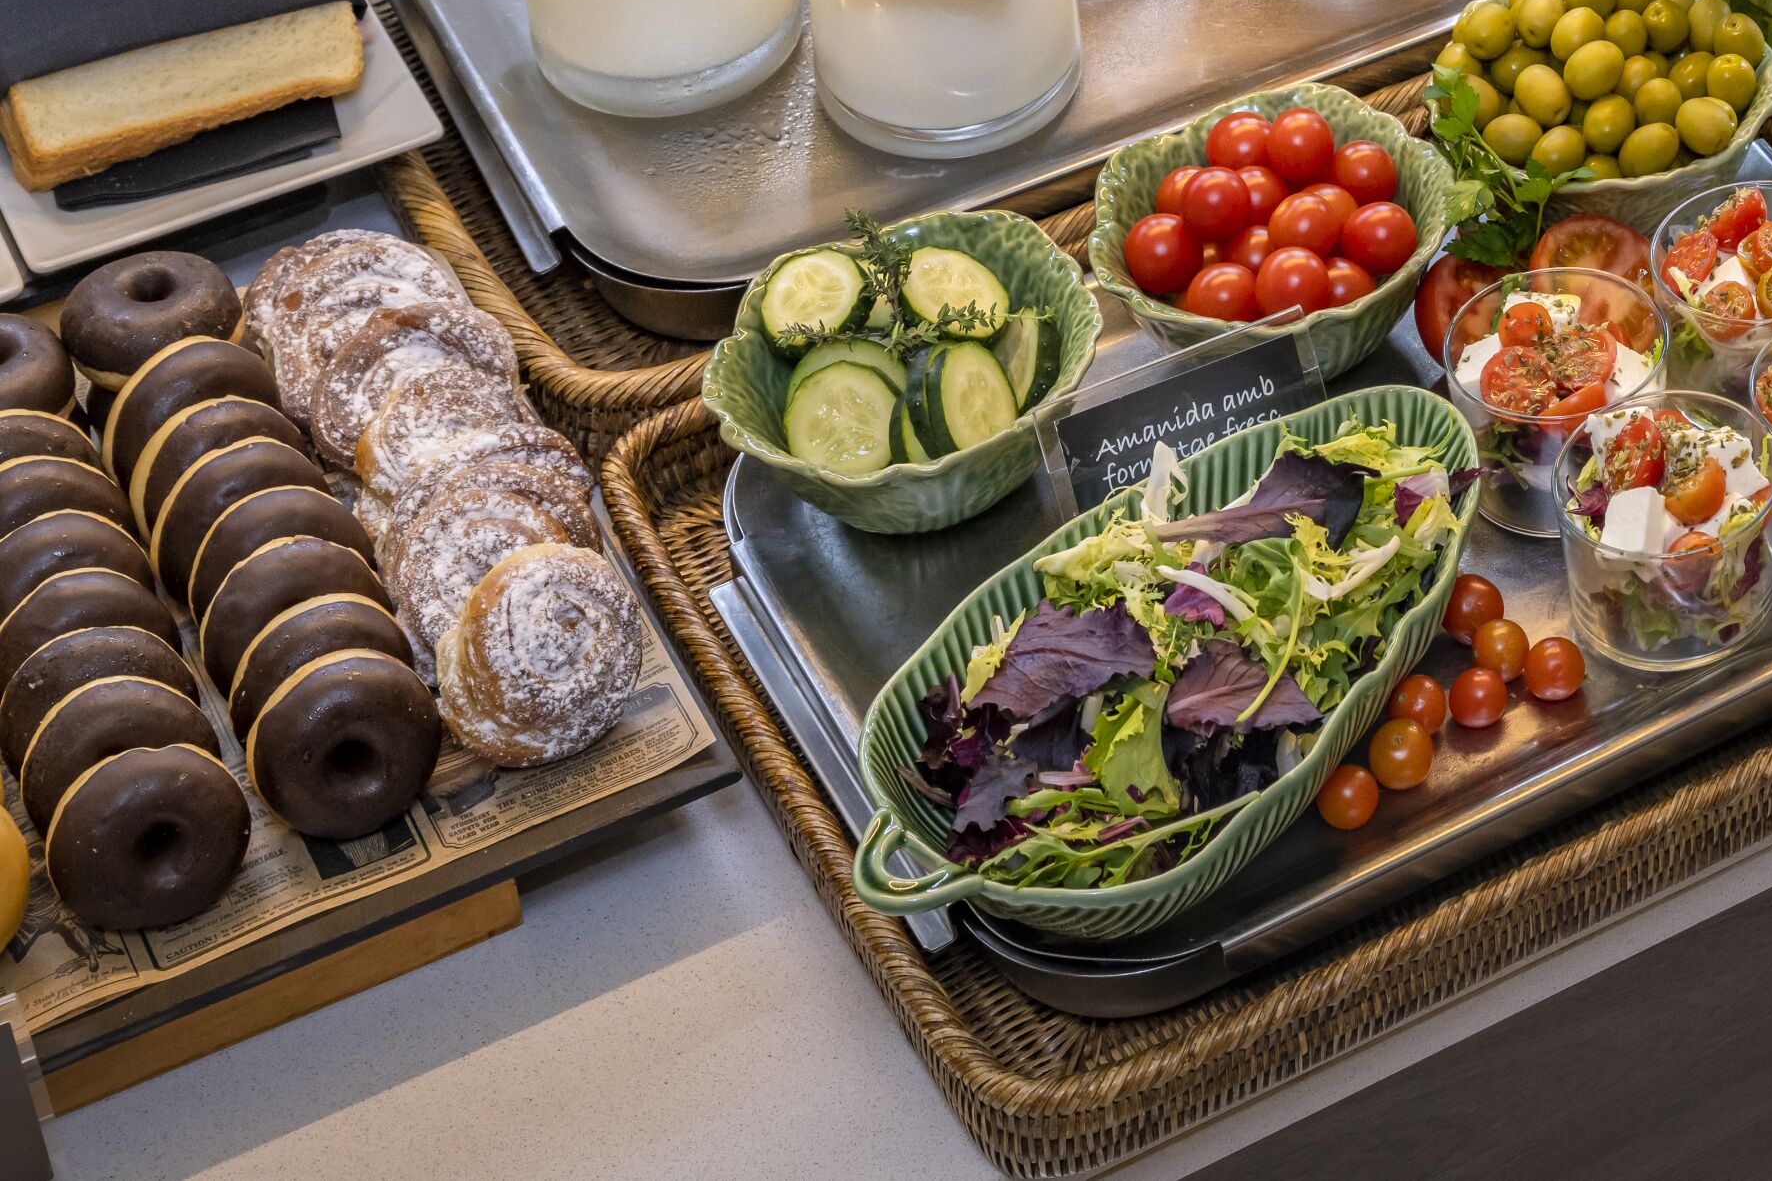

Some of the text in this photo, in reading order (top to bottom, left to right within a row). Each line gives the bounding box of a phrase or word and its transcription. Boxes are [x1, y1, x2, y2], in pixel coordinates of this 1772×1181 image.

[1095, 375, 1275, 463] Amanida amb
[240, 846, 289, 870] FORTABLE.
